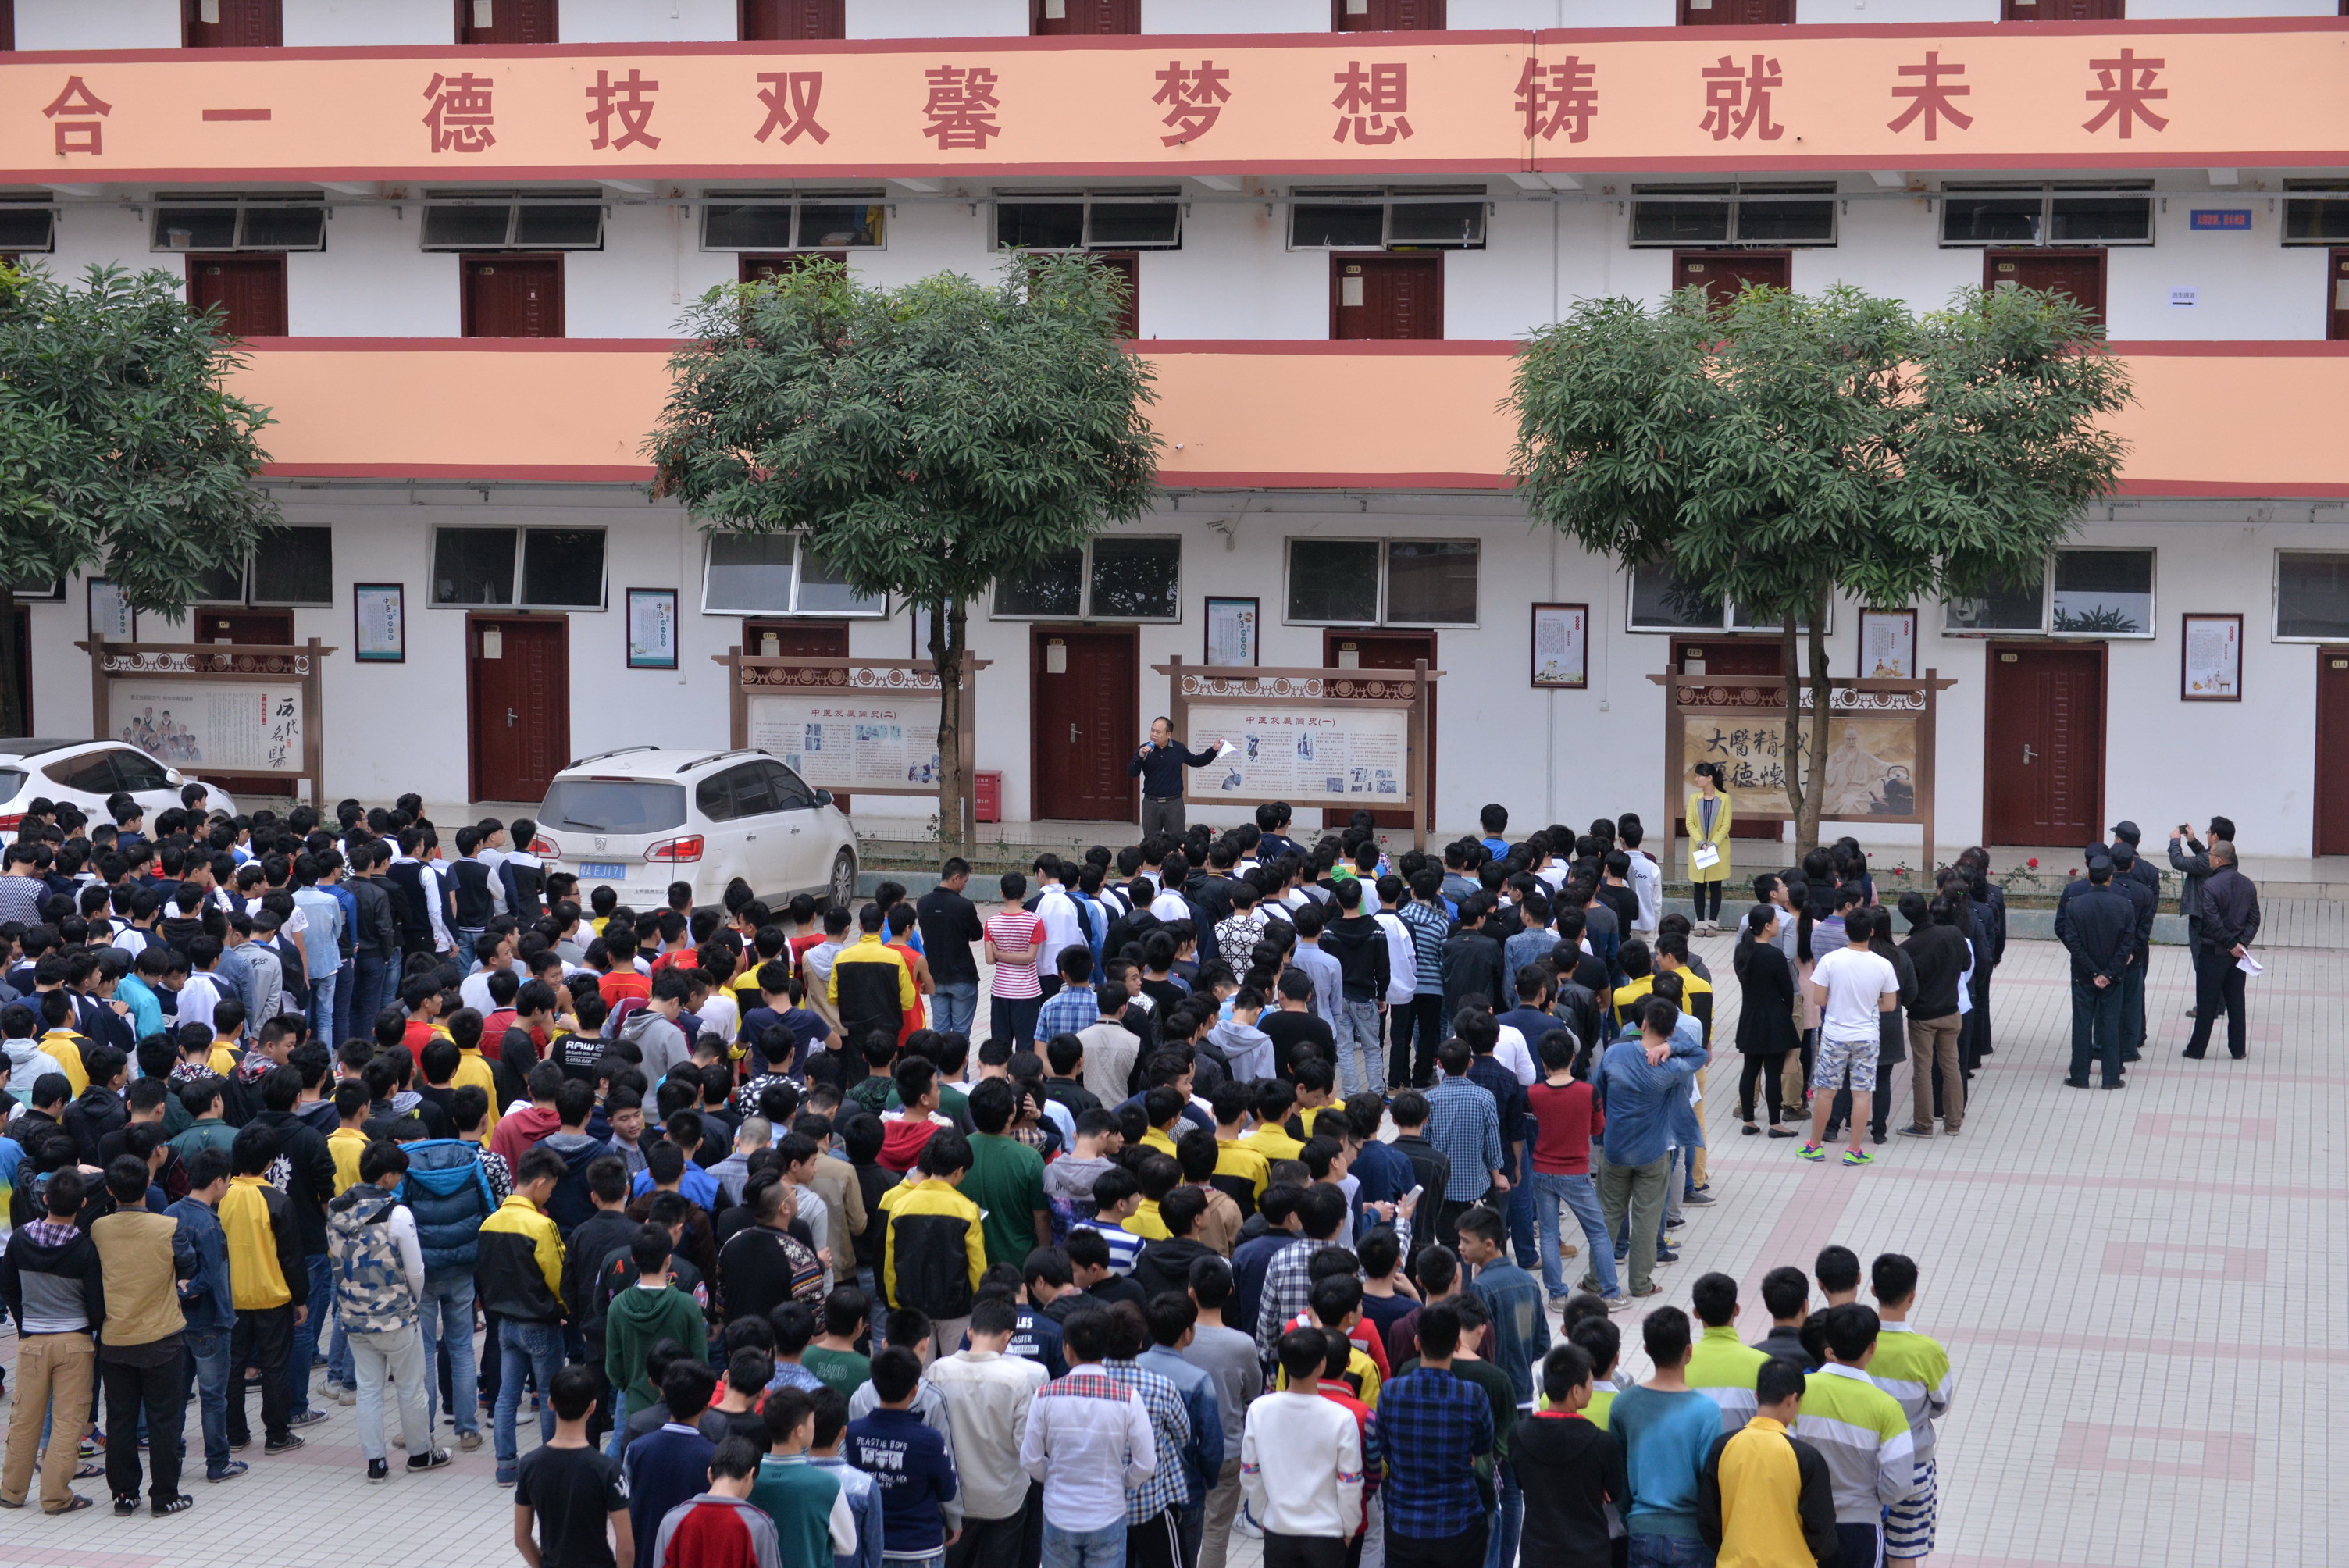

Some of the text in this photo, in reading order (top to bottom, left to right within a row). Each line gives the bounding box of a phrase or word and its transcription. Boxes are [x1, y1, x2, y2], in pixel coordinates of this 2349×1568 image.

[43, 52, 2169, 155] 合一 德技双馨 梦想铸就未来
[565, 1041, 595, 1051] RAW
[857, 1436, 908, 1452] BEASTIE BOYS
